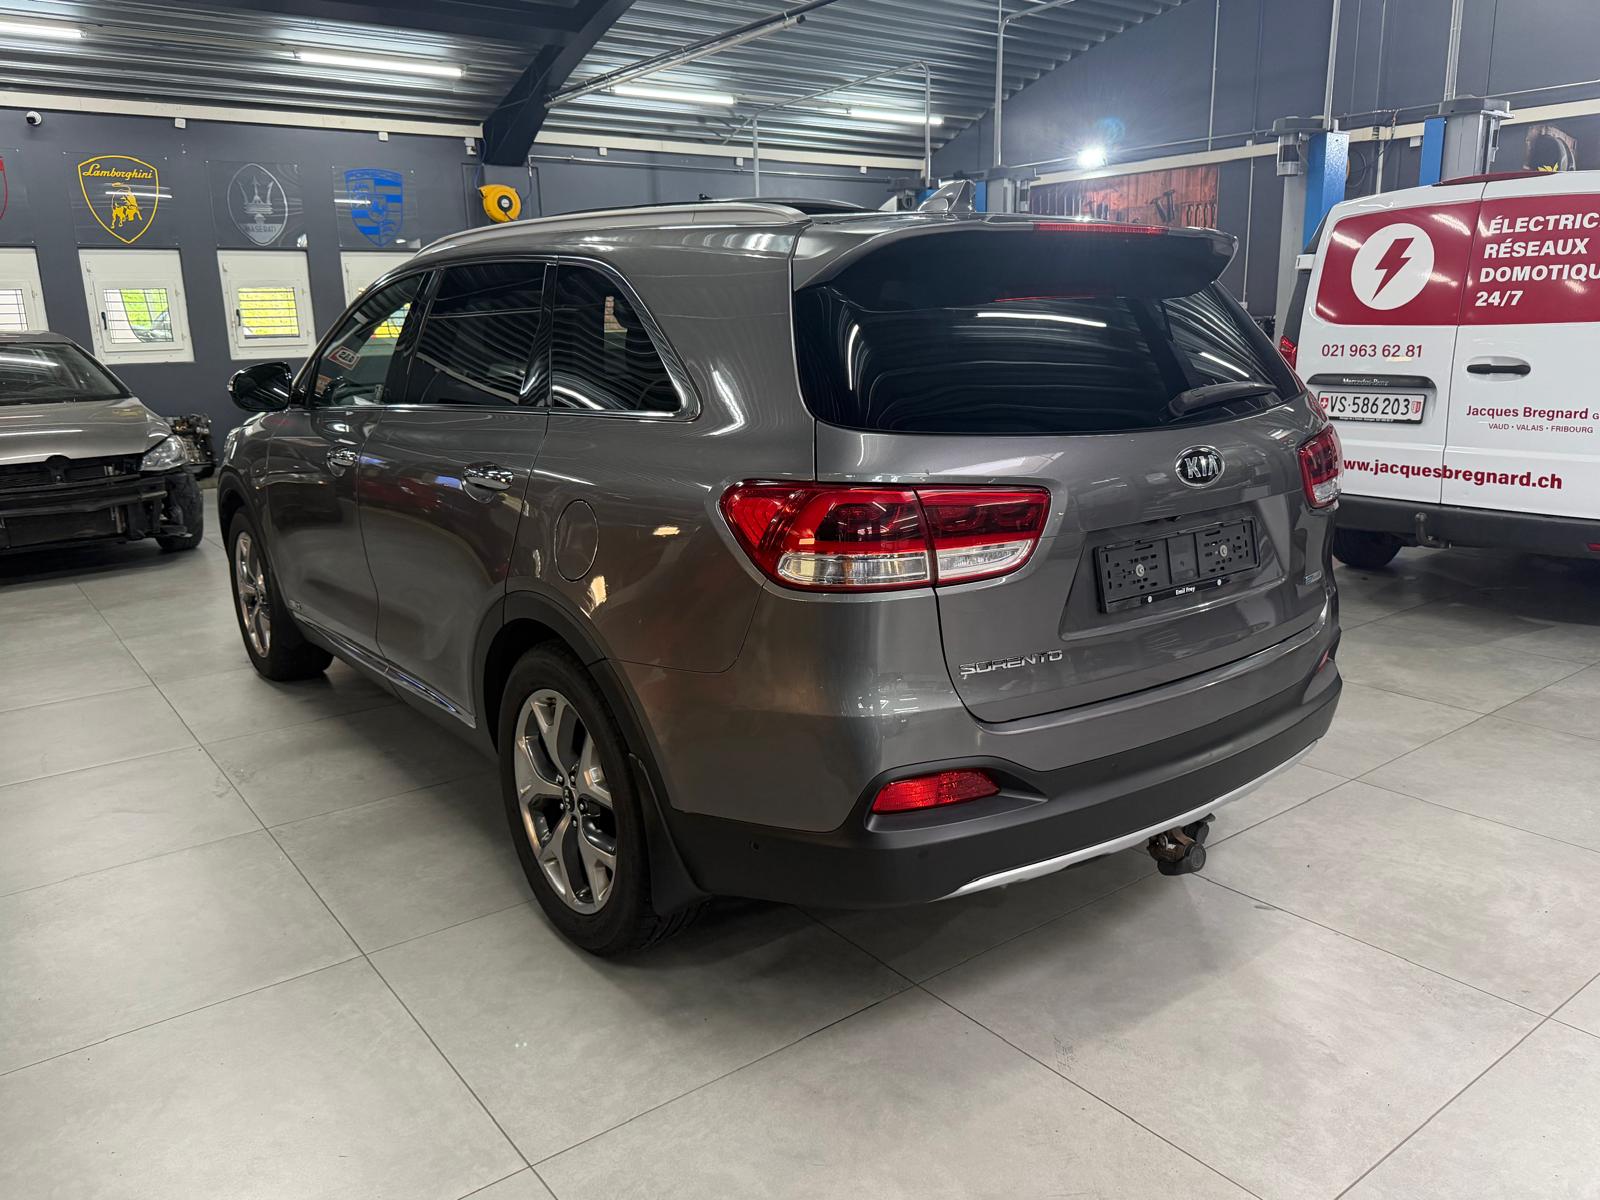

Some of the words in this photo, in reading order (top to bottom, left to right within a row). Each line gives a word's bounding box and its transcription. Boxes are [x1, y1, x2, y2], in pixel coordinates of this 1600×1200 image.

[82, 163, 154, 180] Lamborghini
[1488, 212, 1600, 234] ÉLECTRIC
[1483, 238, 1591, 259] RÉSEAUX
[1474, 290, 1524, 307] 24/7
[1321, 344, 1345, 357] 021
[1349, 344, 1377, 358] 963
[1381, 344, 1401, 358] 62
[1405, 344, 1423, 358] 81
[1466, 405, 1520, 420] Jacques
[1523, 406, 1589, 422] Bregnard
[1488, 423, 1510, 431] VAUD
[1516, 424, 1545, 432] VALAIS
[1550, 425, 1594, 434] FRIBOURG
[1184, 454, 1219, 479] KIA
[959, 649, 1063, 677] SORENTO
